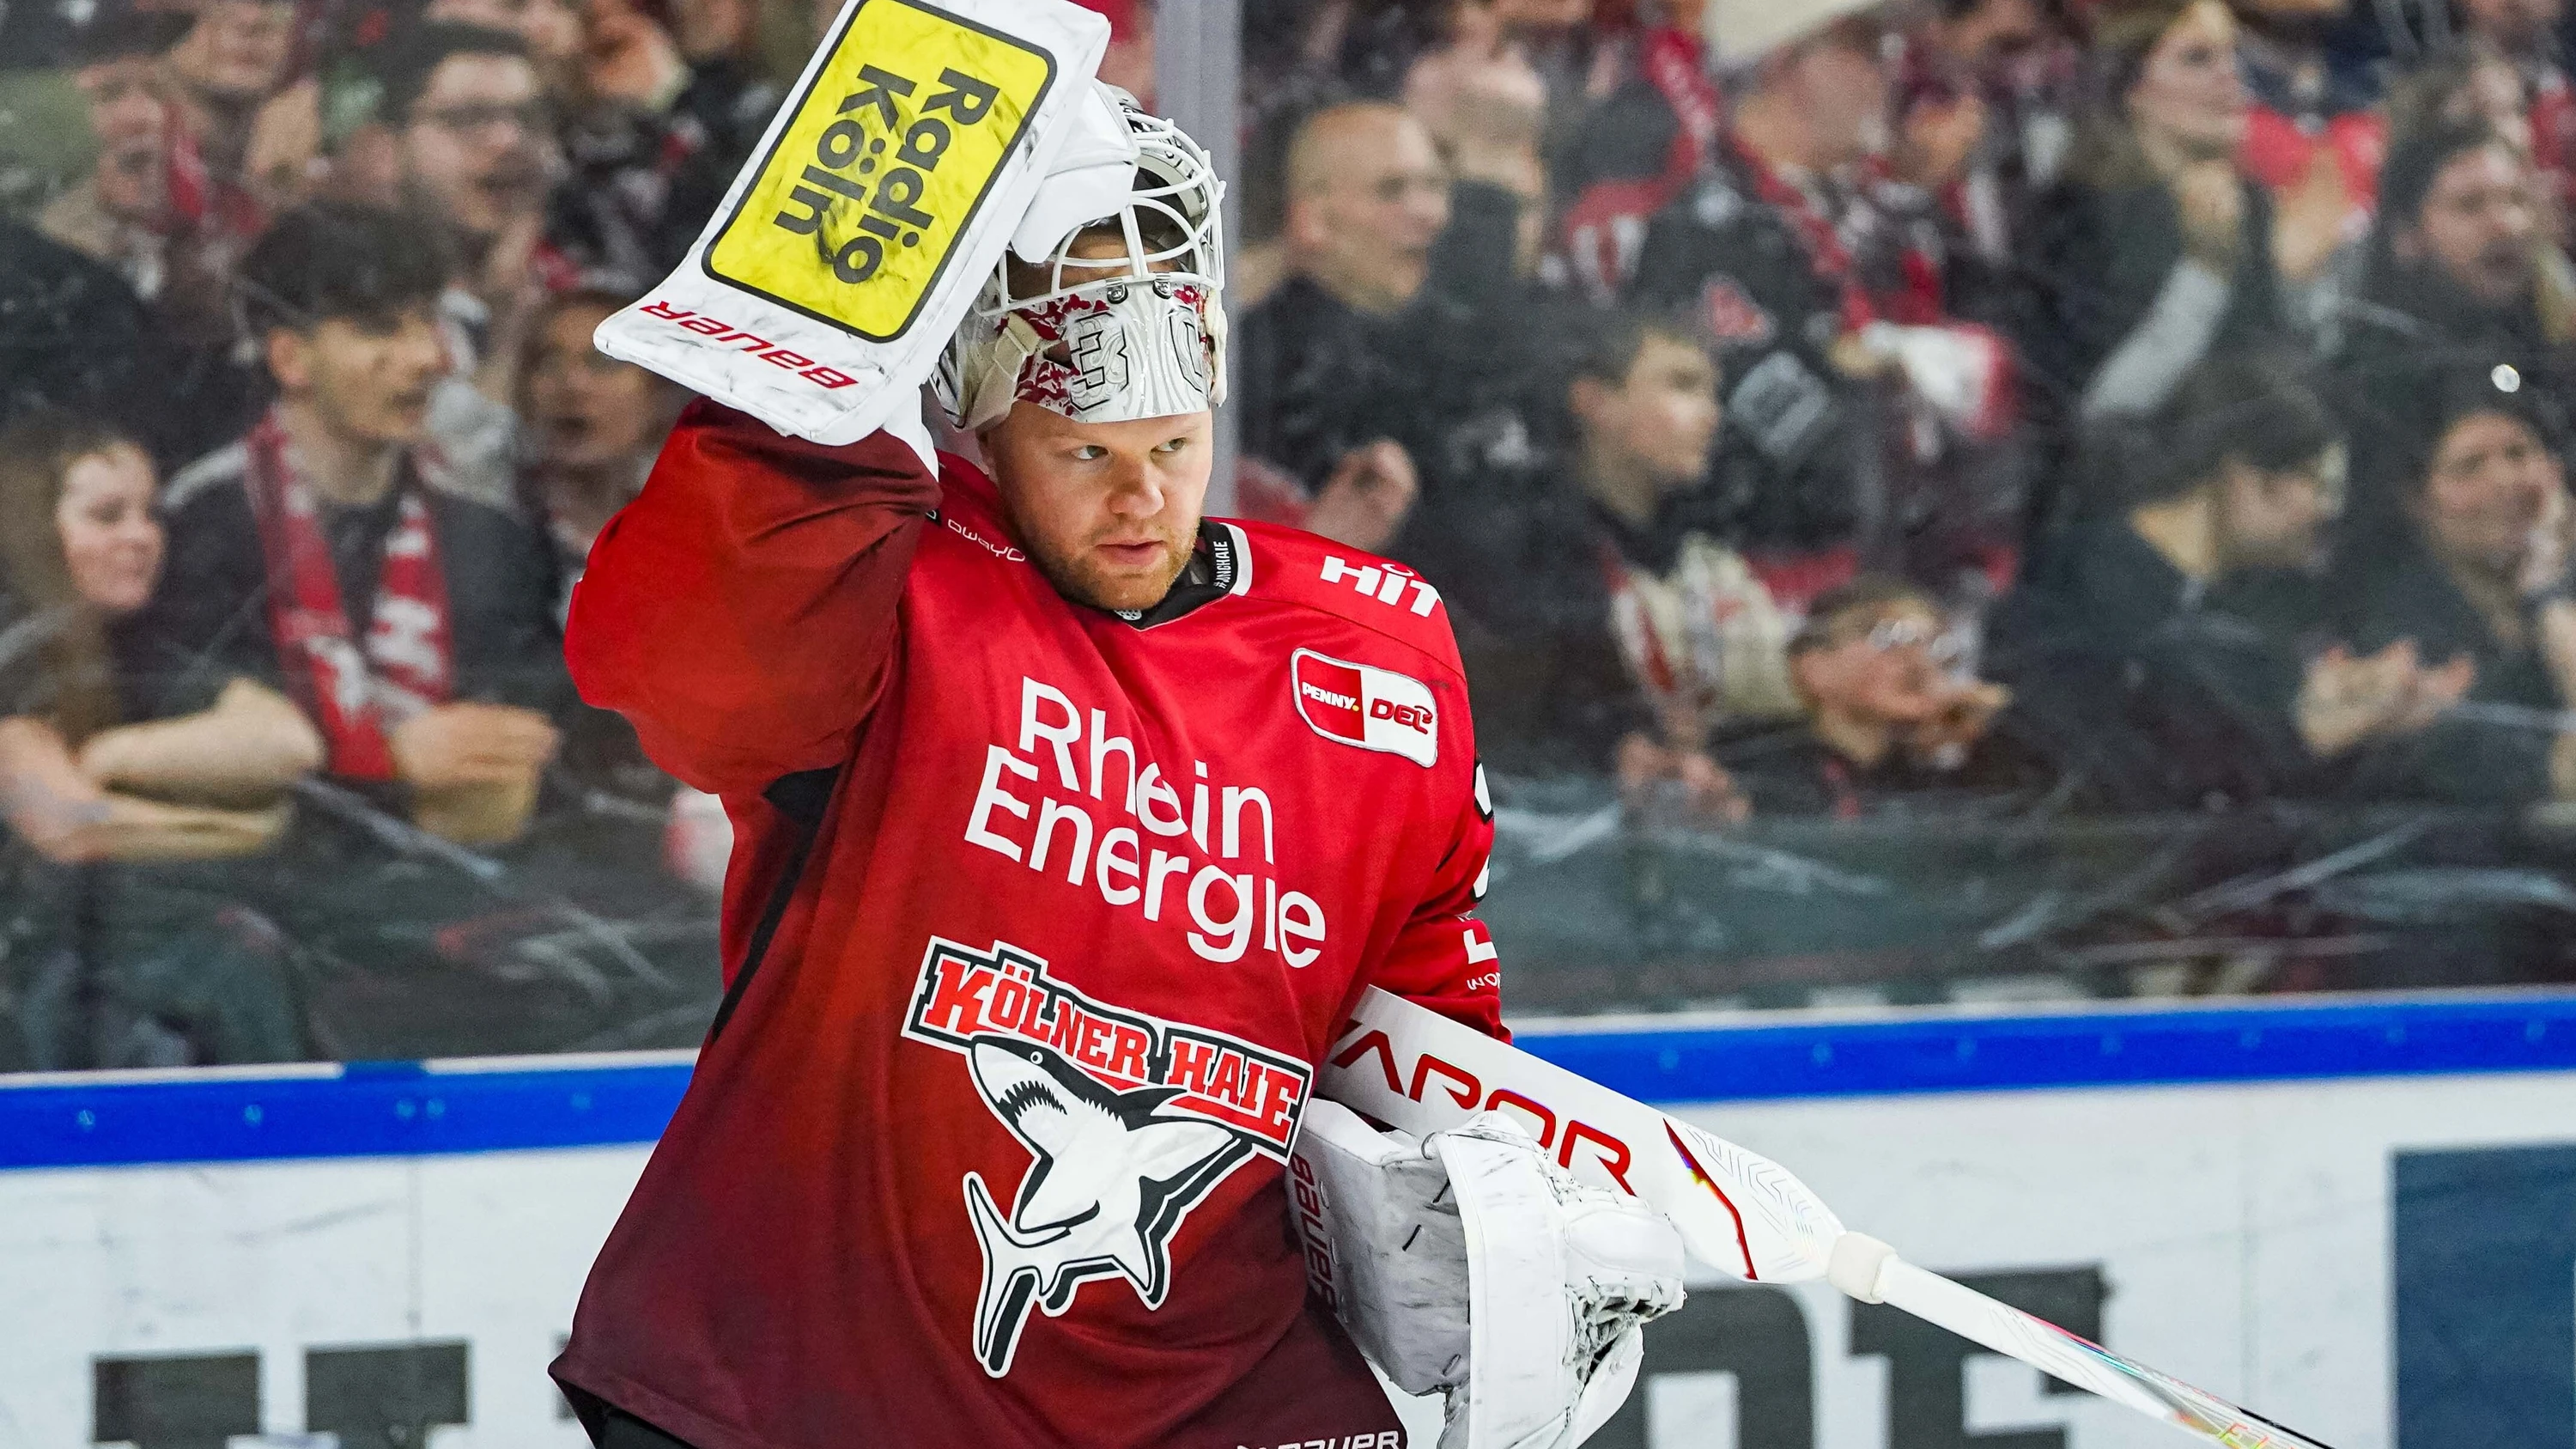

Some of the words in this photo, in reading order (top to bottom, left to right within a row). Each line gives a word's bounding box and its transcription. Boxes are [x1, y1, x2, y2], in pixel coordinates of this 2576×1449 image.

[773, 64, 918, 235] Köln
[833, 67, 1000, 284] Radio
[1320, 555, 1444, 618] HIT
[1018, 676, 1276, 865] Rhein
[1370, 697, 1433, 735] DEL
[964, 744, 1326, 969] Energie
[924, 959, 1150, 1079] KÖLNER
[1168, 1035, 1303, 1145] HAIE
[1331, 1019, 1637, 1198] APOR
